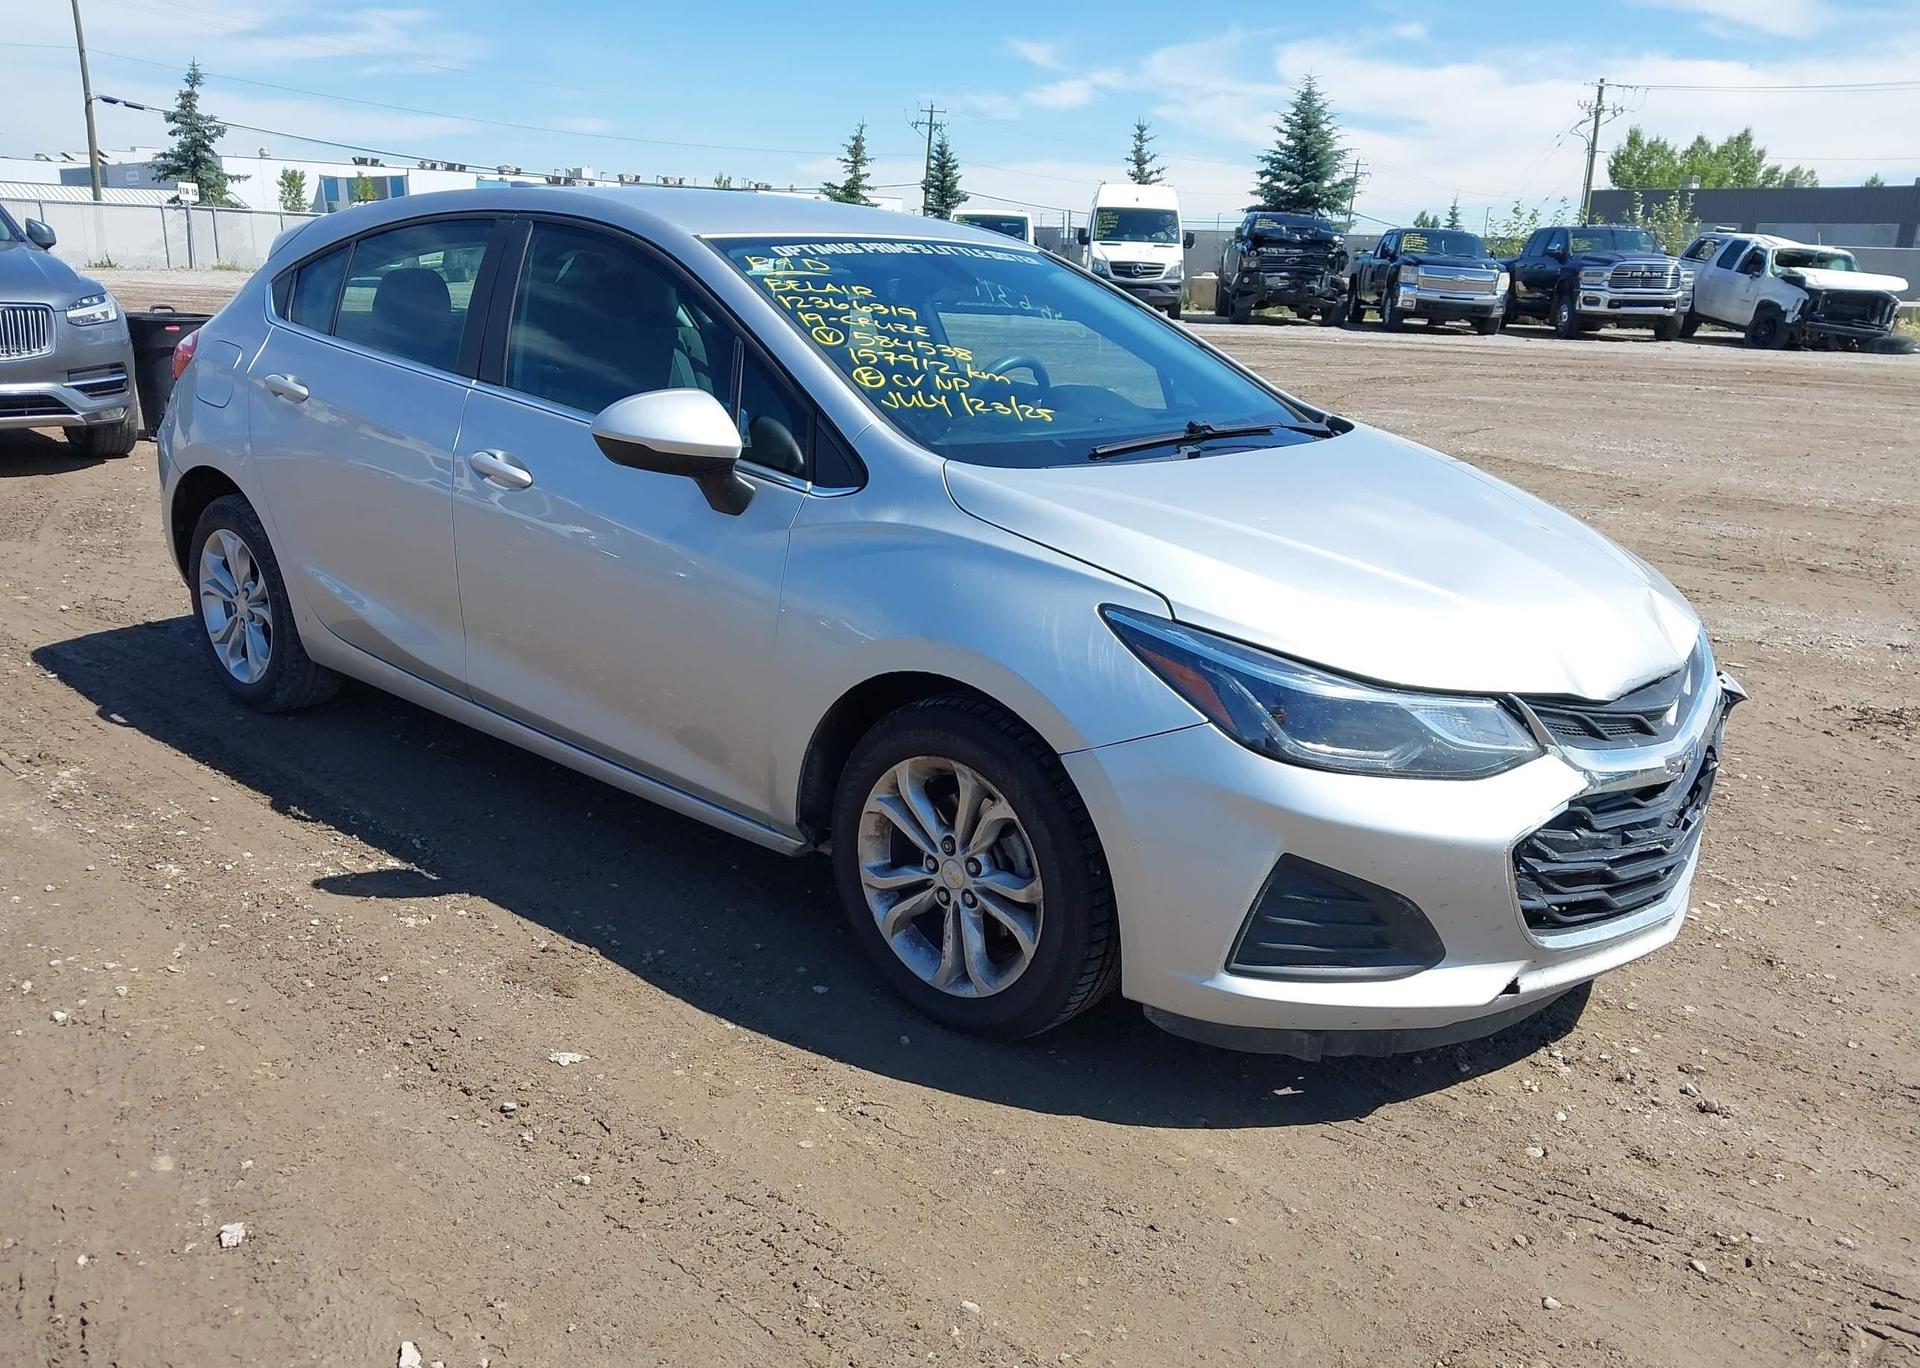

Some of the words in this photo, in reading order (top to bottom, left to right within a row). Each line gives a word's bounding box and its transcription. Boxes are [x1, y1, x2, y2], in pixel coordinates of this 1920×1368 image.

[191, 188, 198, 196] 15
[770, 242, 865, 257] OPTIMUS
[926, 244, 992, 259] LITTLE
[763, 277, 878, 298] BELAIR
[777, 294, 918, 320] 12366319
[852, 331, 973, 360] 584538
[848, 347, 960, 375] 157912
[892, 373, 926, 387] CV
[881, 391, 953, 418] JULY
